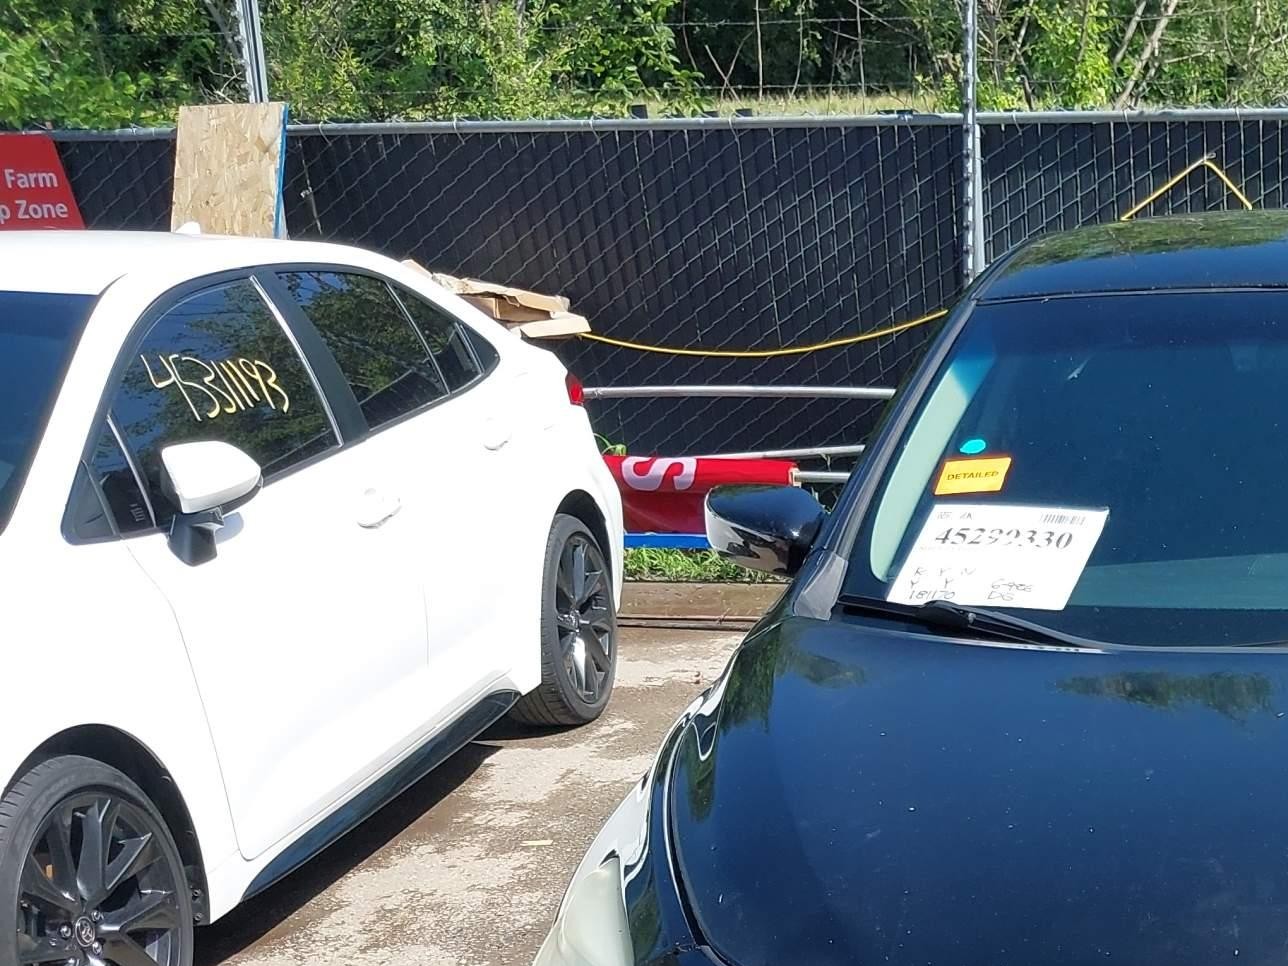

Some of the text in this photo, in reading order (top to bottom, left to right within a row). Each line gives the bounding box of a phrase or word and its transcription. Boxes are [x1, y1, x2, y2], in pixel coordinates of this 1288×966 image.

[4, 169, 59, 189] Farm
[14, 199, 70, 220] Zone
[946, 470, 999, 481] DETAILED
[934, 527, 1074, 550] 45299330
